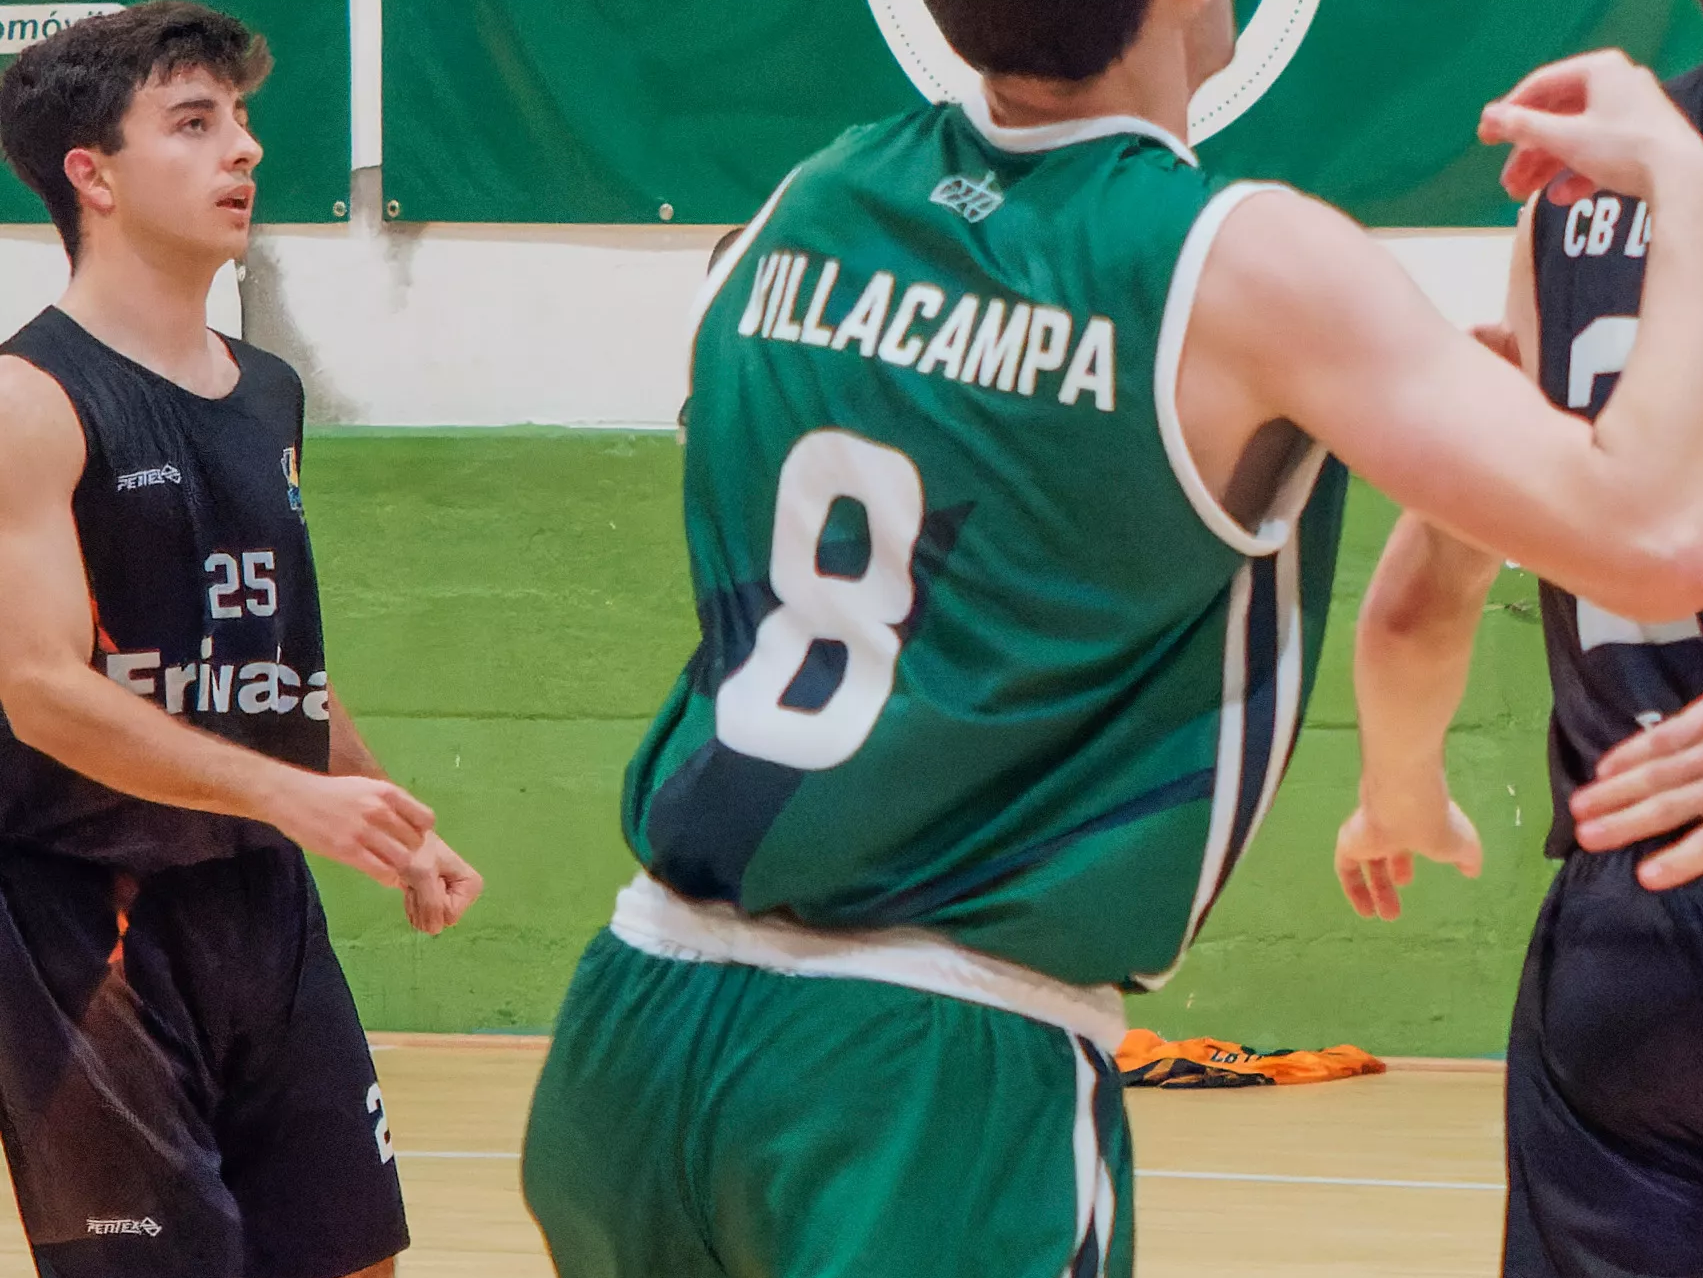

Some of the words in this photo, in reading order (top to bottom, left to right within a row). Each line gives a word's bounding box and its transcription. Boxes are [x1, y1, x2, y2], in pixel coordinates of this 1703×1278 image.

[1563, 197, 1622, 258] CB
[738, 249, 1118, 413] VILLACAMPA
[204, 550, 279, 620] 25
[715, 427, 926, 771] 8
